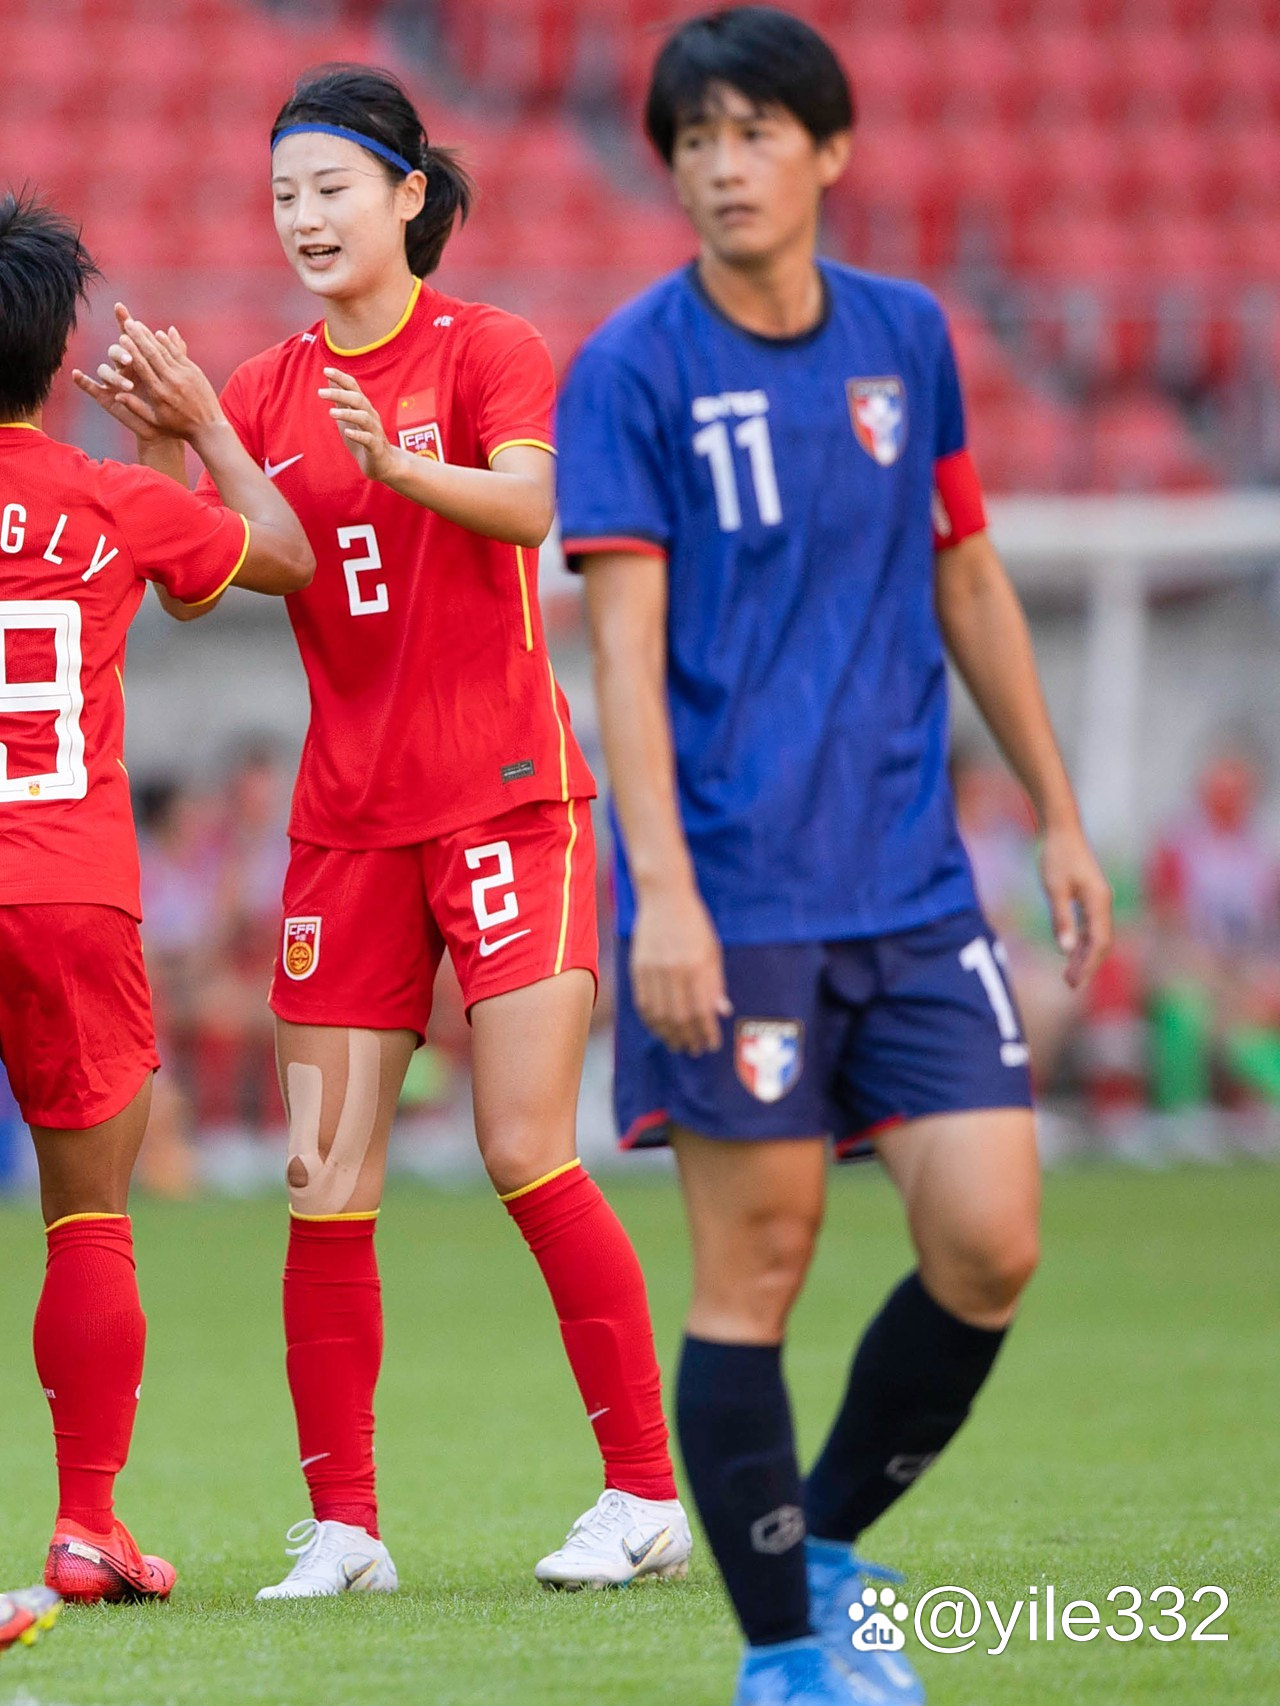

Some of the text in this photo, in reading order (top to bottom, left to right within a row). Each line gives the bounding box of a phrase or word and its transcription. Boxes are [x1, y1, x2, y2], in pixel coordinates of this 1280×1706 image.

[405, 430, 435, 447] CFA
[692, 416, 784, 532] 11
[336, 524, 389, 617] 2
[289, 923, 316, 935] CFA
[464, 840, 519, 931] 2
